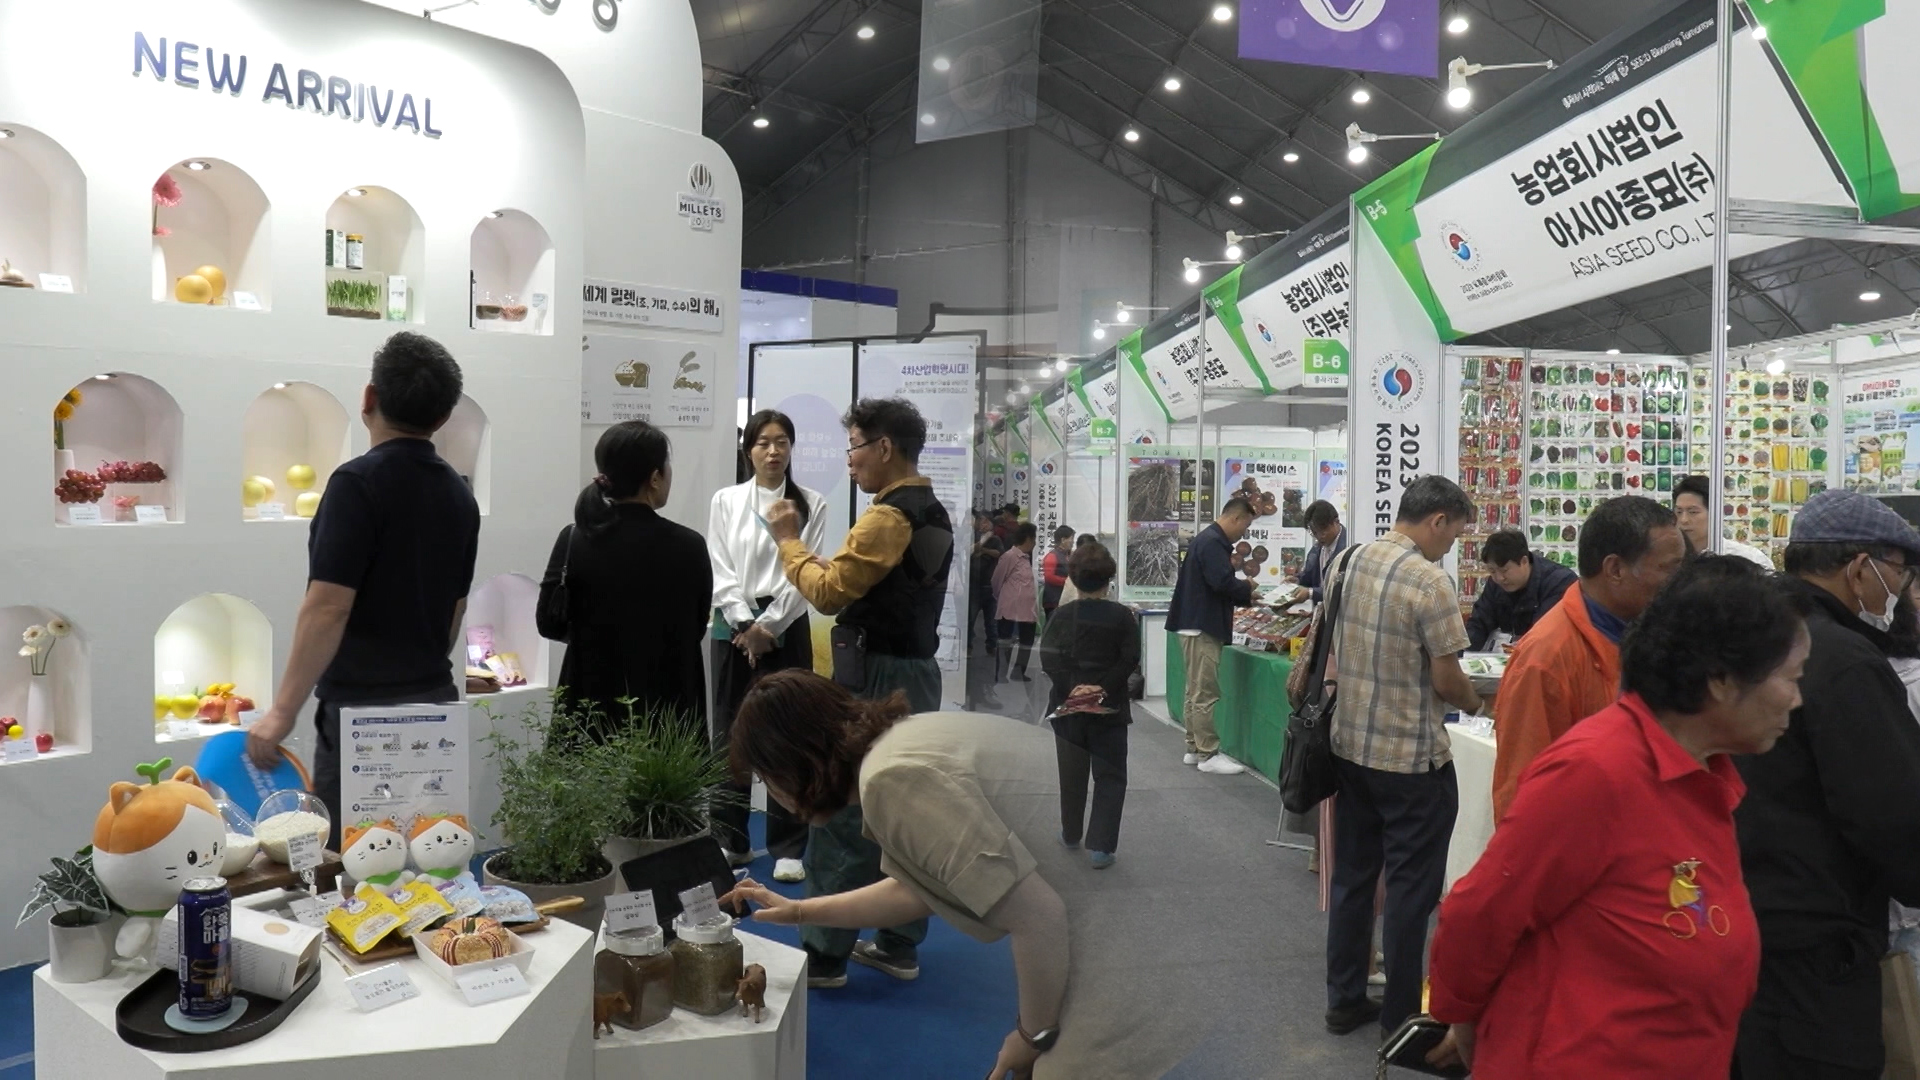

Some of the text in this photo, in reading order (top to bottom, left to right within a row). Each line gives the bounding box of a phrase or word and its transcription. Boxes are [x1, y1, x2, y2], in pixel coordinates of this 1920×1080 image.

[133, 31, 443, 138] NEW ARRIVAL
[1630, 51, 1651, 70] SEED
[1511, 98, 1684, 206] 농업회사법인
[679, 201, 722, 218] MILLETS
[1544, 152, 1715, 248] 아시아종묘(주)
[1570, 252, 1608, 279] ASIA
[1605, 235, 1655, 266] SEED
[1655, 224, 1700, 251] CO.,
[583, 284, 607, 304] 세계
[1313, 353, 1341, 369] B-6
[1375, 423, 1392, 542] KOREA SEE
[1400, 423, 1420, 489] 2023
